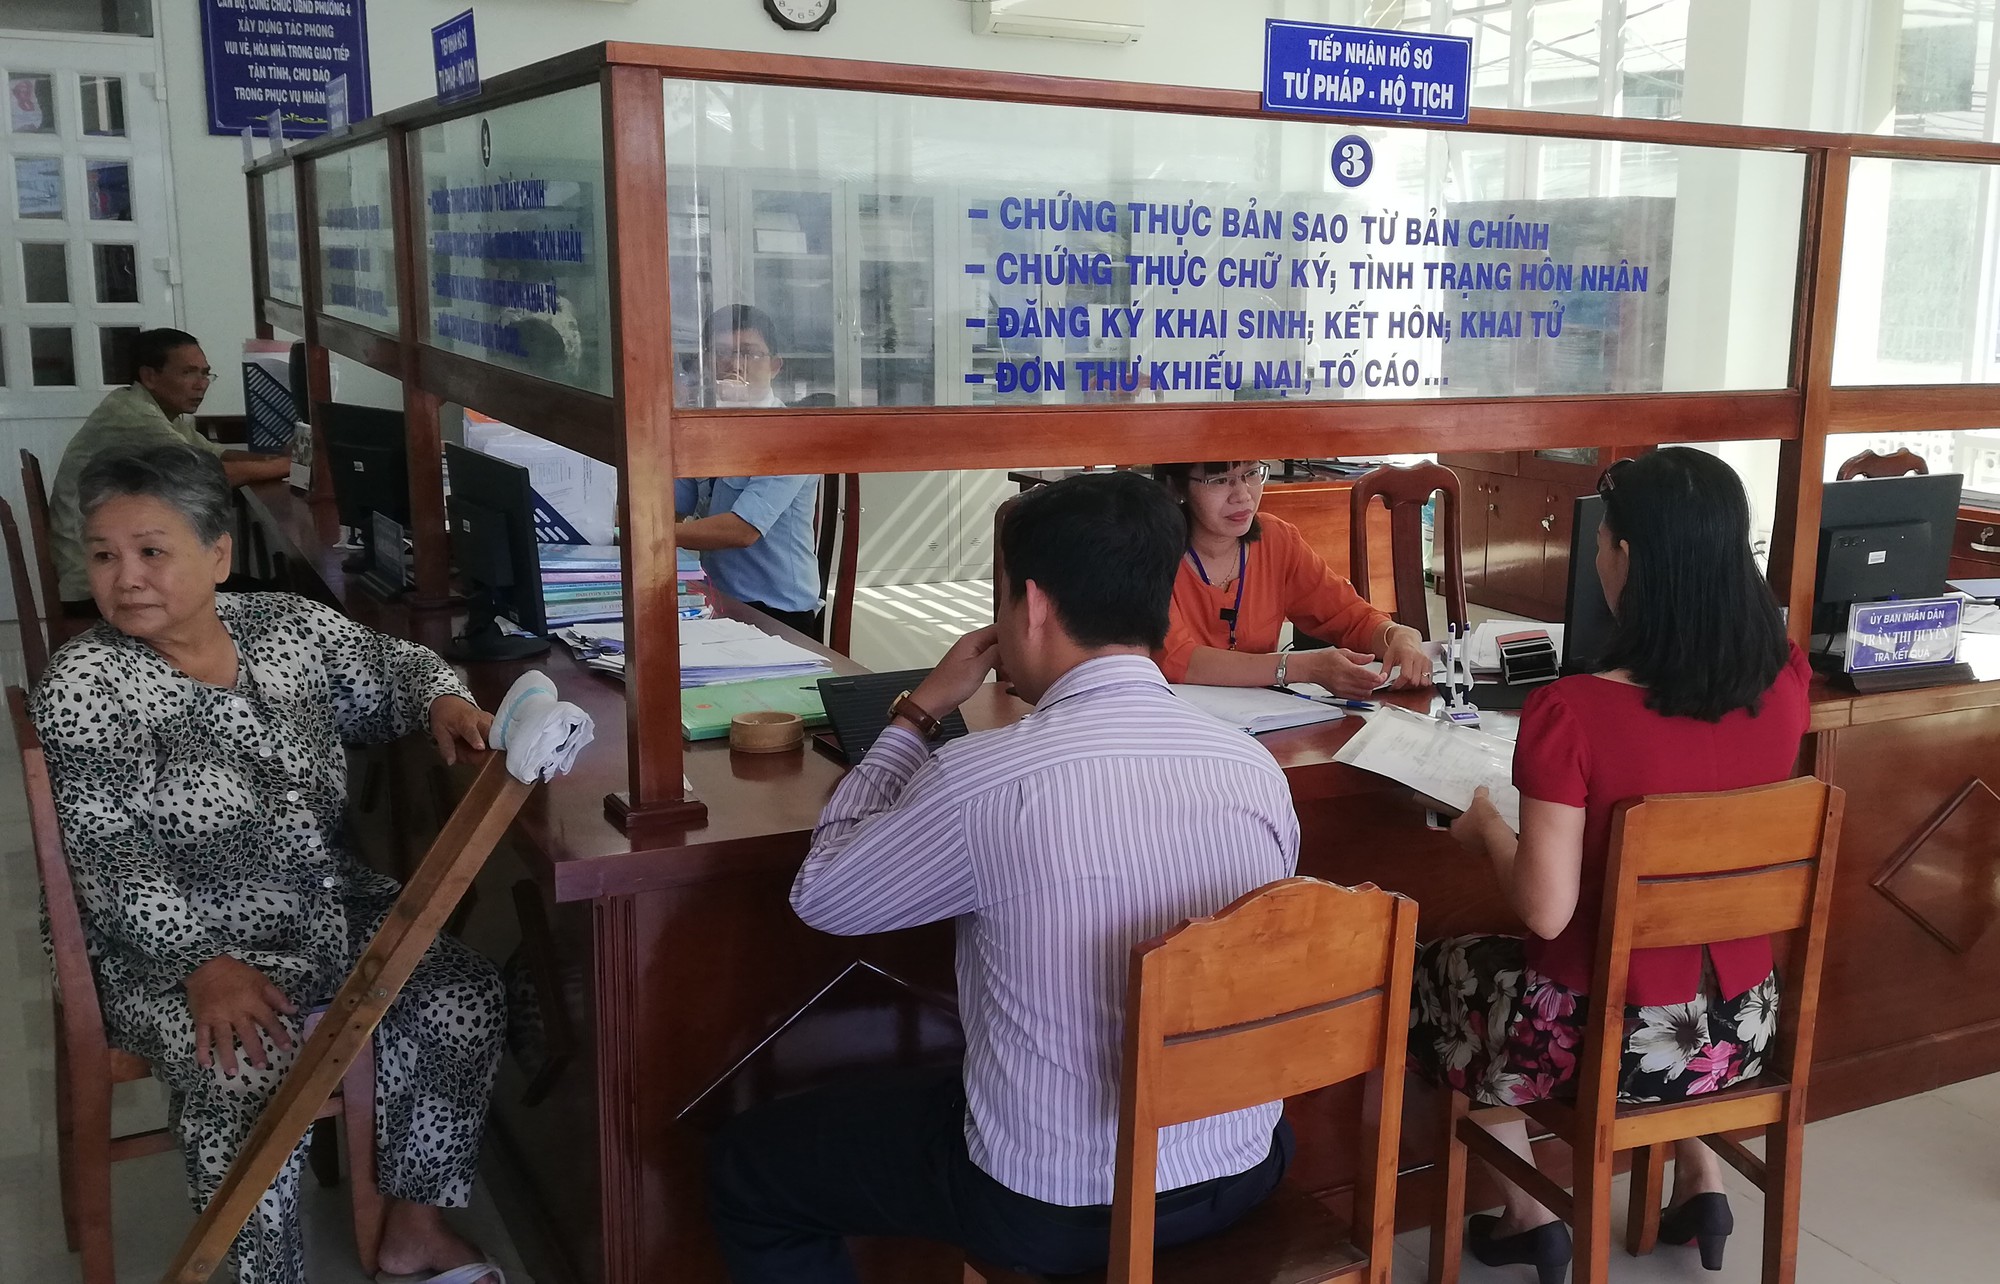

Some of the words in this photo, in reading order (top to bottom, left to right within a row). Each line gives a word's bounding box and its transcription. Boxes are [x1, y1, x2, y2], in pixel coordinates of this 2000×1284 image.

[293, 0, 313, 14] UBND
[346, 3, 351, 17] 4
[258, 19, 283, 38] DỰNG
[304, 24, 334, 39] PHONG
[224, 41, 238, 55] VUI
[287, 44, 313, 59] TRONG
[314, 46, 332, 60] GIAO
[332, 43, 350, 62] TIẾP
[1309, 34, 1342, 62] TIẾP
[1345, 40, 1387, 71] NHẬN
[1389, 40, 1411, 67] HỒ
[1413, 46, 1434, 69] SƠ
[248, 62, 266, 82] TẬN
[267, 63, 292, 83] TÌNH,
[293, 68, 311, 82] CHU
[312, 65, 330, 82] ĐÁO
[234, 86, 263, 101] TRONG
[265, 88, 287, 107] PHỤC
[289, 90, 302, 107] VỤ
[302, 89, 325, 105] NHÂN
[1283, 67, 1312, 98] TƯ
[1314, 69, 1364, 102] PHÁP
[1380, 75, 1405, 112] HỘ
[1412, 81, 1454, 115] TỊCH
[1339, 144, 1365, 177] 3
[1000, 190, 1117, 232] CHỨNG
[1127, 197, 1212, 246] THỰC
[1221, 198, 1282, 240] BẢN
[1291, 212, 1348, 244] SAO
[1361, 208, 1399, 245] TỪ
[1405, 207, 1459, 247] BẢN
[1468, 214, 1550, 250] CHÍNH
[996, 246, 1113, 285] CHỨNG
[1126, 250, 1208, 294] THỰC
[1217, 251, 1282, 288] CHỮ
[1290, 252, 1337, 294] KÝ;
[1349, 254, 1414, 290] TÌNH
[1423, 262, 1512, 300] TRẠNG
[1521, 257, 1572, 292] HÔN
[1581, 259, 1648, 293] NHÂN
[996, 298, 1091, 339] ĐĂNG
[1101, 300, 1144, 338] KÝ
[1155, 308, 1228, 339] KHAI
[1238, 310, 1314, 345] SINH;
[1324, 301, 1380, 339] KẾT
[1388, 304, 1451, 344] HÔN;
[1460, 310, 1522, 338] KHAI
[1530, 299, 1566, 339] TỬ
[995, 357, 1066, 393] ĐƠN
[1075, 358, 1142, 393] THƯ
[1150, 350, 1244, 393] KHIẾU
[1254, 360, 1311, 397] NẠI,
[1319, 350, 1359, 390] TỐ
[1870, 612, 1882, 625] ỦY
[1883, 614, 1901, 624] BAN
[1902, 609, 1925, 622] NHÂN
[1927, 608, 1945, 620] DÂN
[1862, 626, 1892, 647] TRẦN
[1893, 630, 1912, 645] THỊ
[1913, 621, 1948, 642] HUYỀN
[1892, 646, 1908, 660] KẾT
